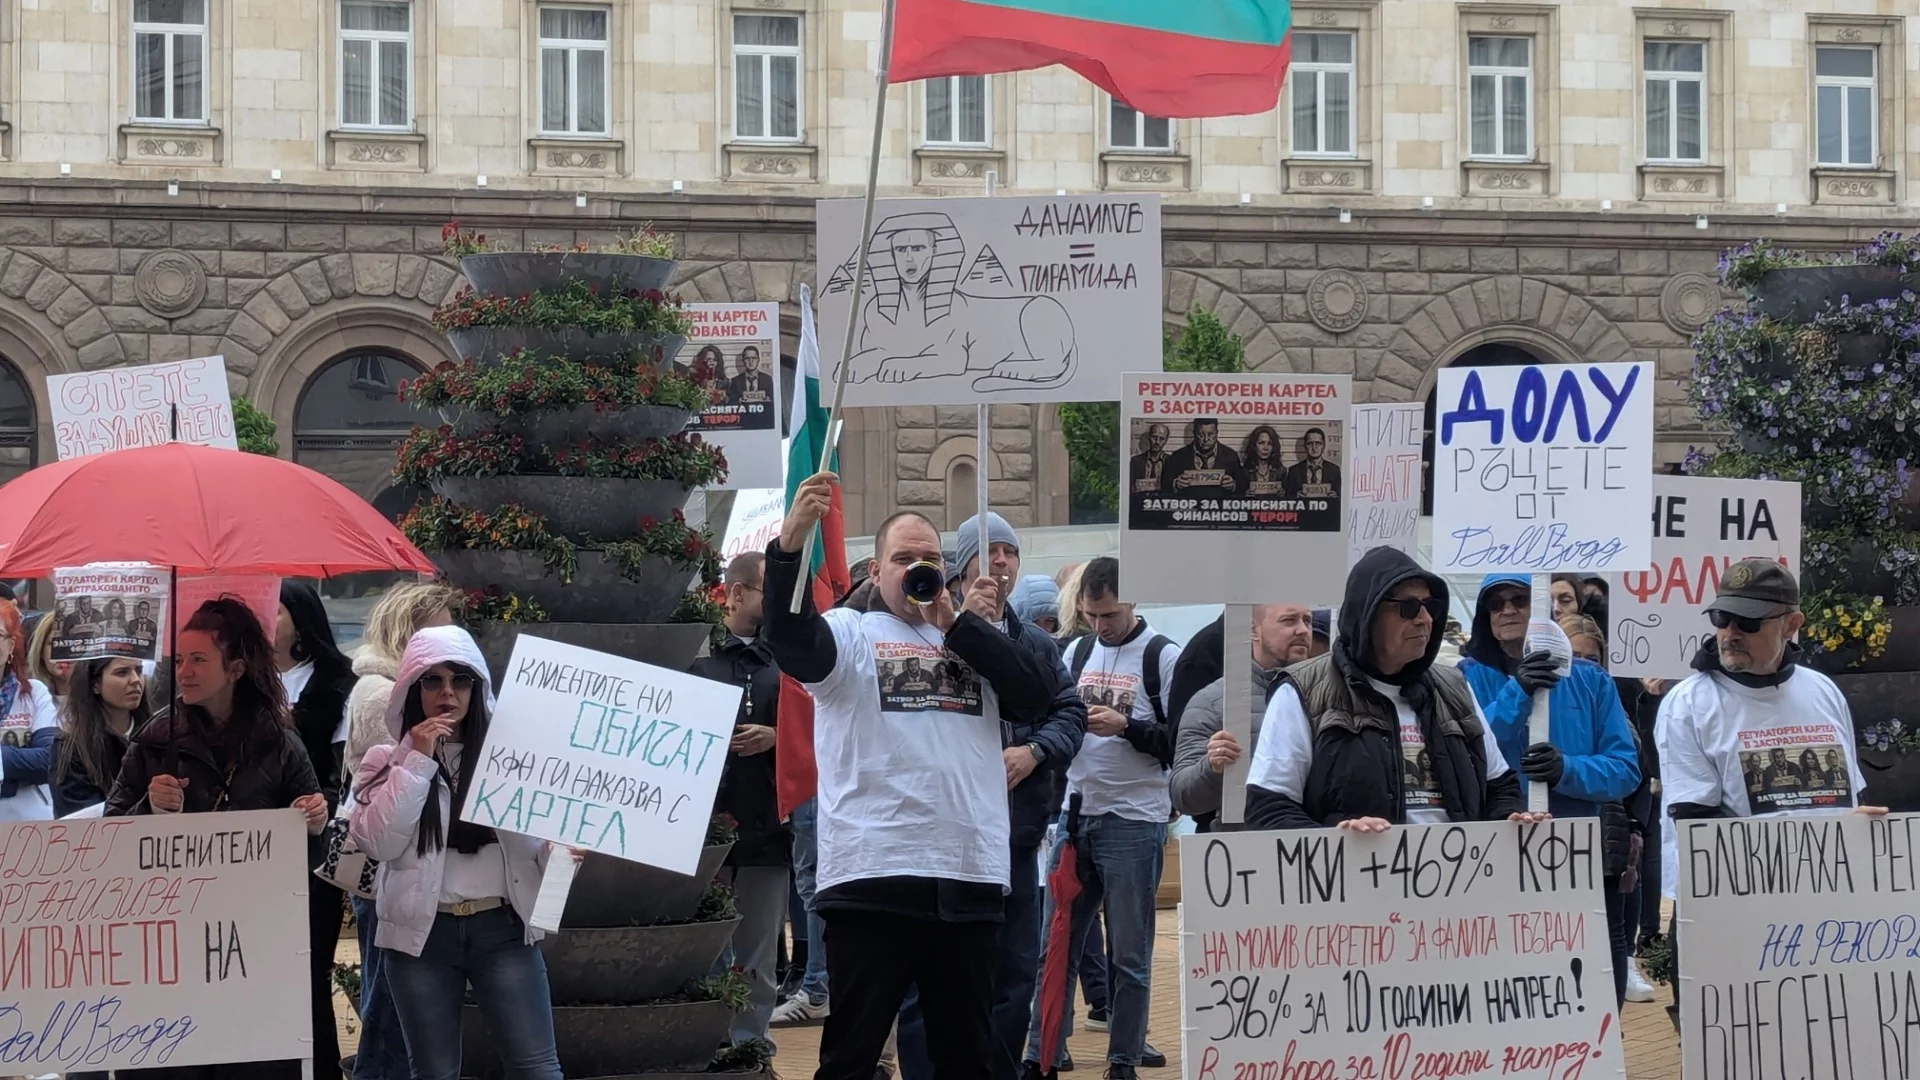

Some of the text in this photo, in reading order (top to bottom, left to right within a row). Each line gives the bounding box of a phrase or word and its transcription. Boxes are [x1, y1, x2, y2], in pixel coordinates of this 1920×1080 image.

[1014, 203, 1144, 237] ДАНАИЛОВ
[1019, 263, 1138, 292] ПИРАМИДА
[713, 310, 767, 322] КАРТЕЛ
[61, 359, 208, 416] СПРЕТЕ
[1138, 382, 1338, 398] РЕГУЛАТОРЕН КАРТЕЛ
[1143, 401, 1325, 416] В ЗАСТРАХОВАНЕТО
[1441, 365, 1640, 446] ДОЛУ
[1454, 446, 1628, 492] РЪЦЕТЕ
[1143, 499, 1328, 511] ЗАТВОР ЗА КОМИСИЯТА ПО
[1172, 511, 1249, 522] ФИНАНСОВ
[1515, 492, 1566, 519] ОТ
[1720, 498, 1778, 541] НА
[515, 657, 673, 715] КЛИЕНТИТЕ НИ
[570, 700, 725, 776] ОБИЧАТ
[486, 745, 536, 782] КФН
[539, 756, 570, 790] ГИ
[571, 764, 662, 816] НАКАЗВА
[471, 778, 626, 857] КАРТЕЛ
[139, 830, 272, 873] ОЦЕНИТЕЛИ
[1276, 835, 1345, 904] МКИ
[1360, 826, 1497, 898] +469%
[1517, 822, 1593, 892] КФН
[1689, 820, 1855, 898] БЛОКИРАХА
[0, 877, 217, 924] РГАНИЗИРАТ
[204, 920, 247, 983] НА
[1236, 923, 1300, 972] МОЛИВ
[1407, 920, 1428, 962] ЗА
[1432, 916, 1499, 961] ФАЛИТА
[1508, 911, 1585, 954] ТВЪРДИ
[1759, 923, 1803, 971] НА
[1300, 991, 1329, 1034] ЗА
[1342, 970, 1371, 1033] 10
[1380, 983, 1472, 1032] ГОДИНИ
[1484, 957, 1585, 1025] НАПРЕД!
[1701, 974, 1853, 1080] ВНЕСЕН
